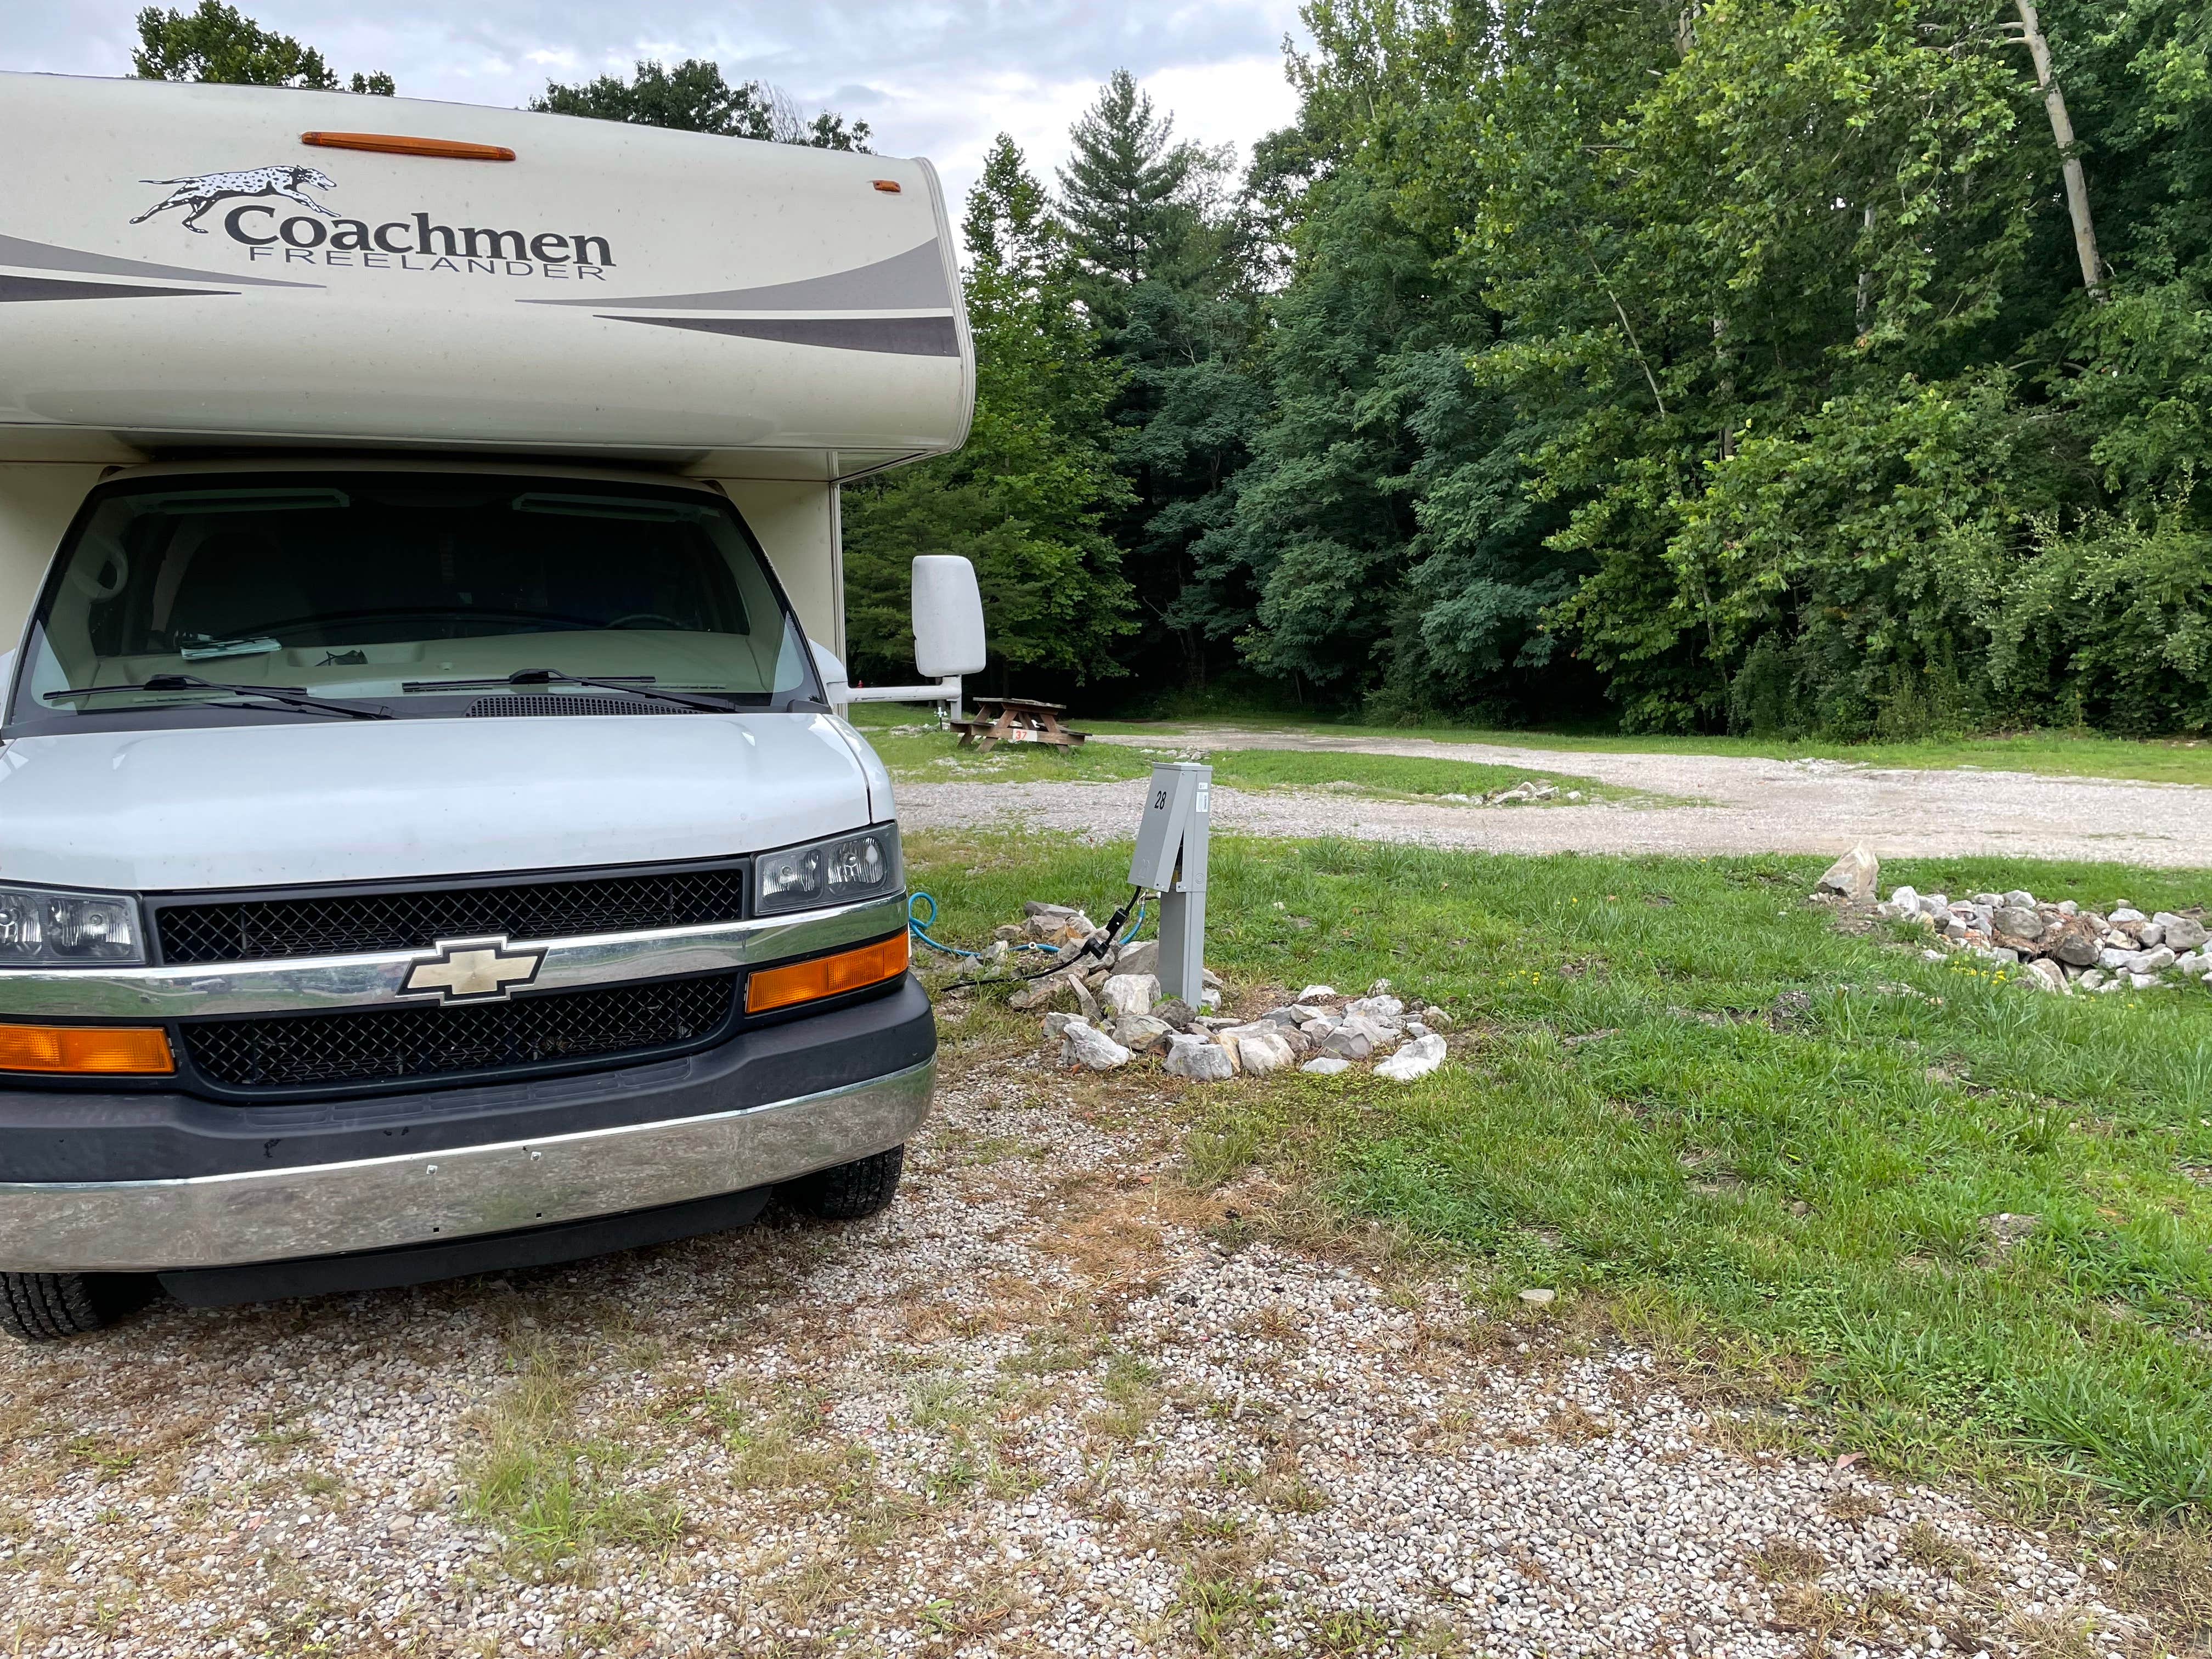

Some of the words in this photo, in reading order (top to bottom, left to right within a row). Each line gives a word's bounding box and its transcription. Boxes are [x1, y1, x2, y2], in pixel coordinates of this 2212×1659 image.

[224, 205, 617, 267] Coachmen
[250, 246, 606, 281] FREELANDER
[1015, 731, 1028, 740] 37
[1154, 790, 1167, 810] 28
